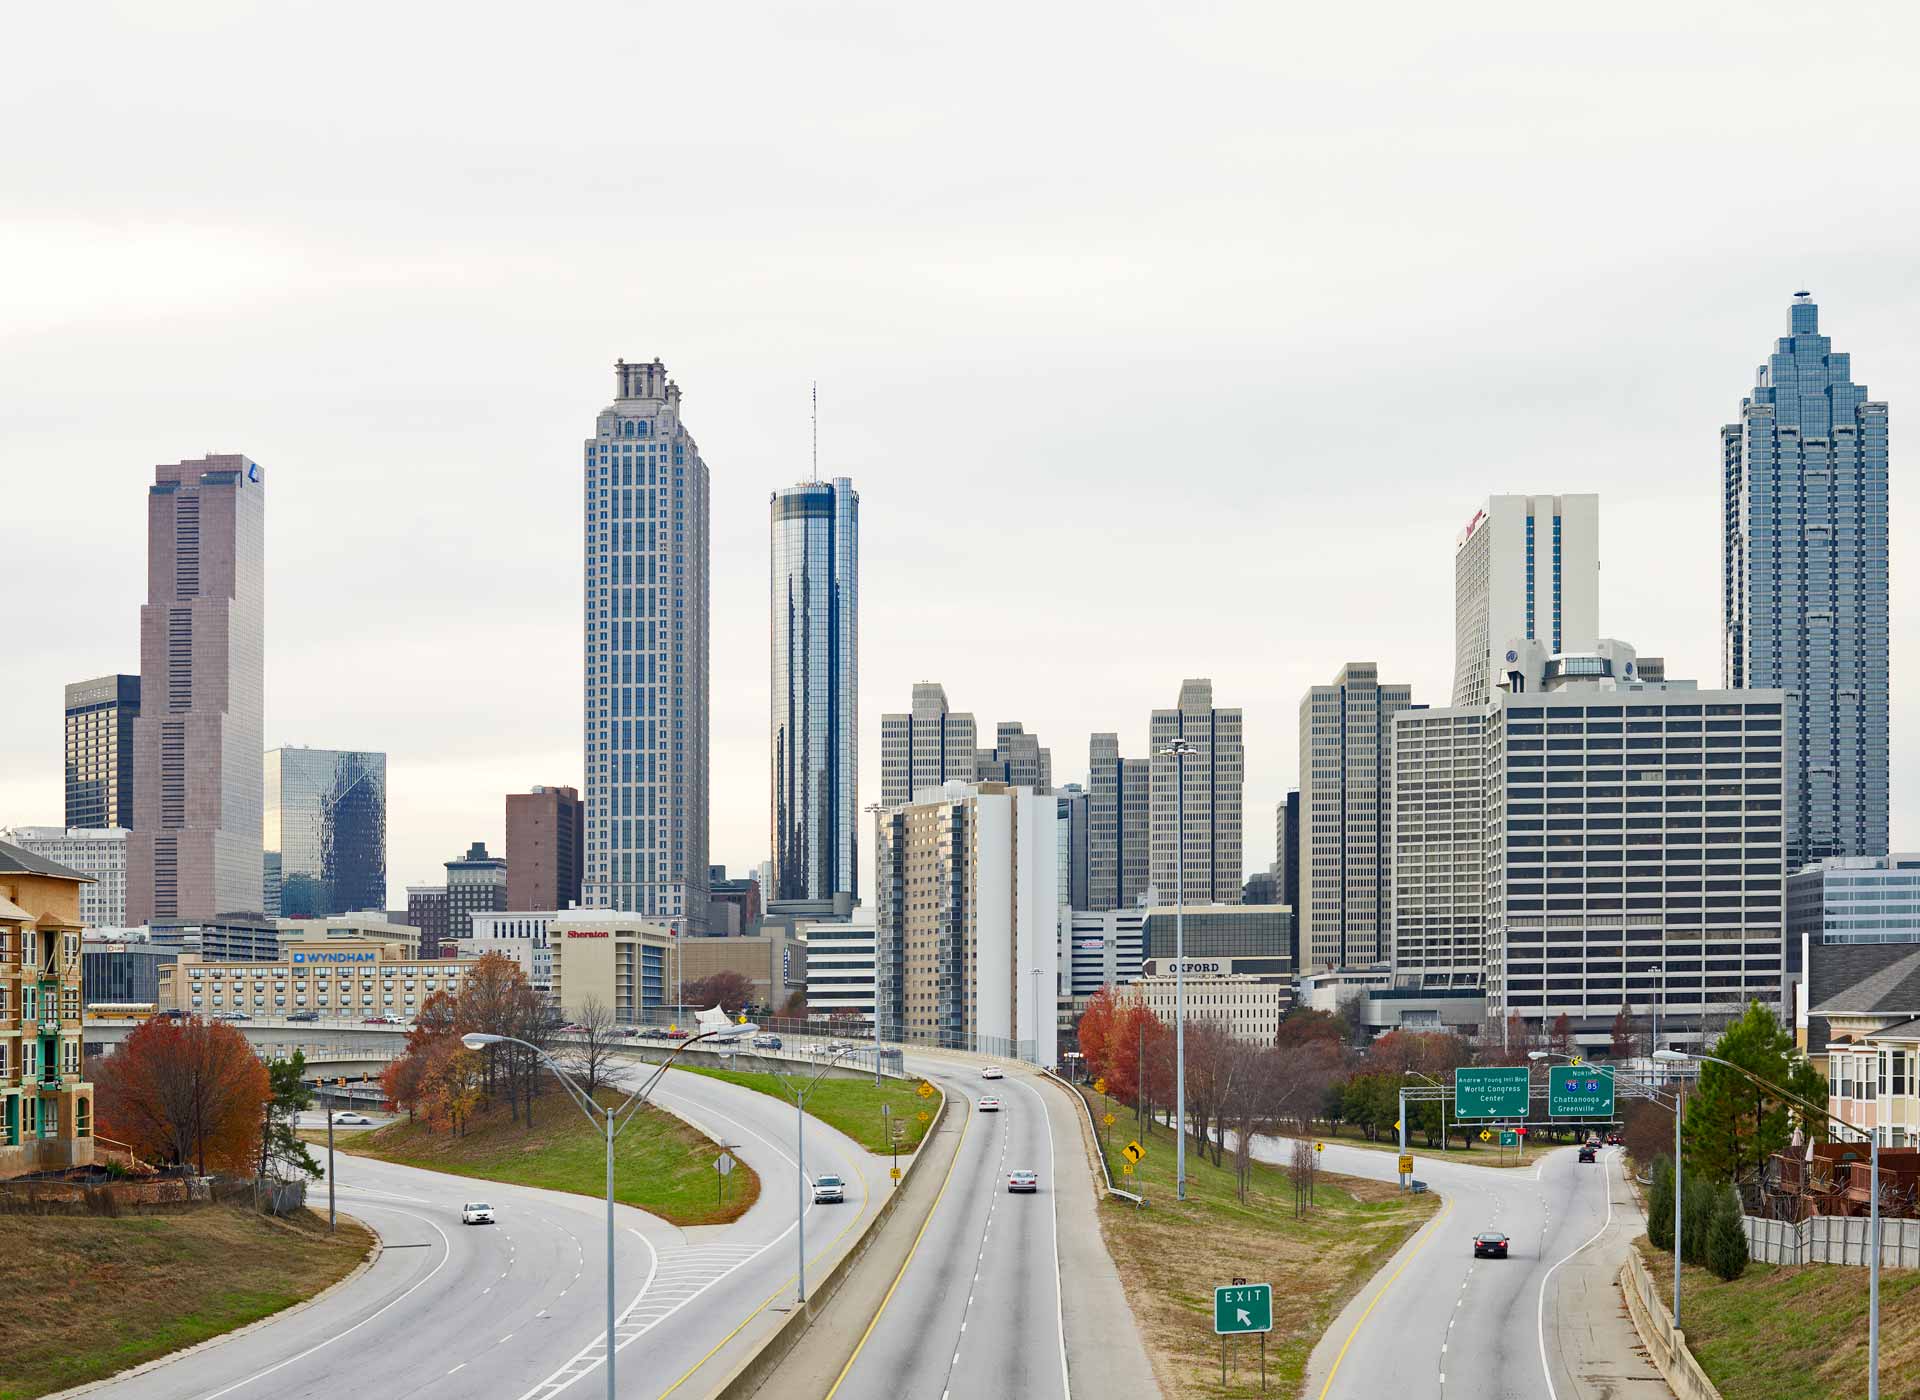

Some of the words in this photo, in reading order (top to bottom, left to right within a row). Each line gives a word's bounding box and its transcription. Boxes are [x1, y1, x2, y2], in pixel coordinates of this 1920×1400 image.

[567, 930, 609, 938] Sheraton
[307, 952, 376, 963] WYNDHAM
[1464, 1085, 1485, 1093] World
[1487, 1085, 1521, 1094] Congress
[1567, 1082, 1577, 1090] 75
[1587, 1082, 1597, 1090] 85
[1553, 1096, 1600, 1104] Chattanooga
[1557, 1105, 1596, 1113] Greenville
[1224, 1289, 1262, 1303] EXIT
